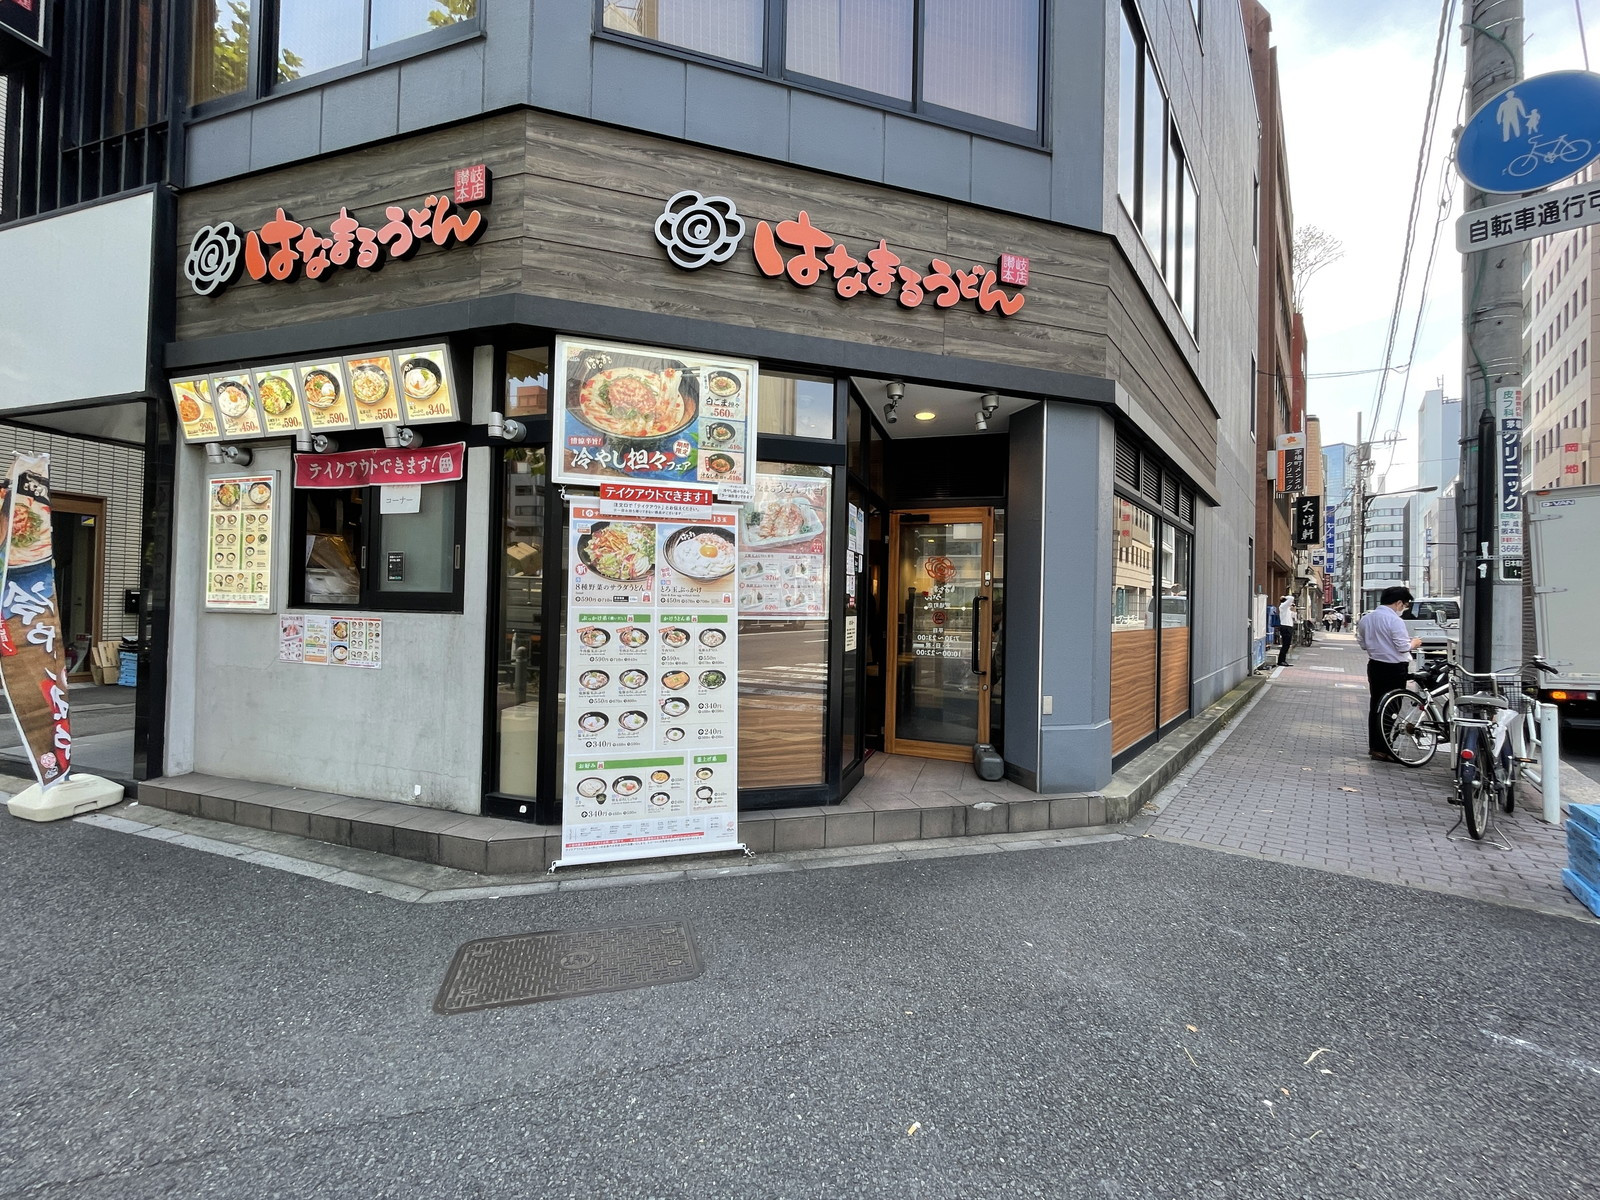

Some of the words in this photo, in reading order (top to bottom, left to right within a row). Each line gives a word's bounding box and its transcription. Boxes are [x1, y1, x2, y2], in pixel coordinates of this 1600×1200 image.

[245, 194, 482, 281] はなまるうどん
[753, 211, 1026, 317] はなまるうどん
[308, 455, 439, 480] テイクアウトできます!
[1503, 433, 1519, 510] クリニック
[385, 496, 414, 505] コーナー
[605, 486, 709, 505] テイクアウトできます!
[1302, 500, 1315, 540] 大洋軒
[575, 582, 645, 592] 8種野菜のサラダうどん
